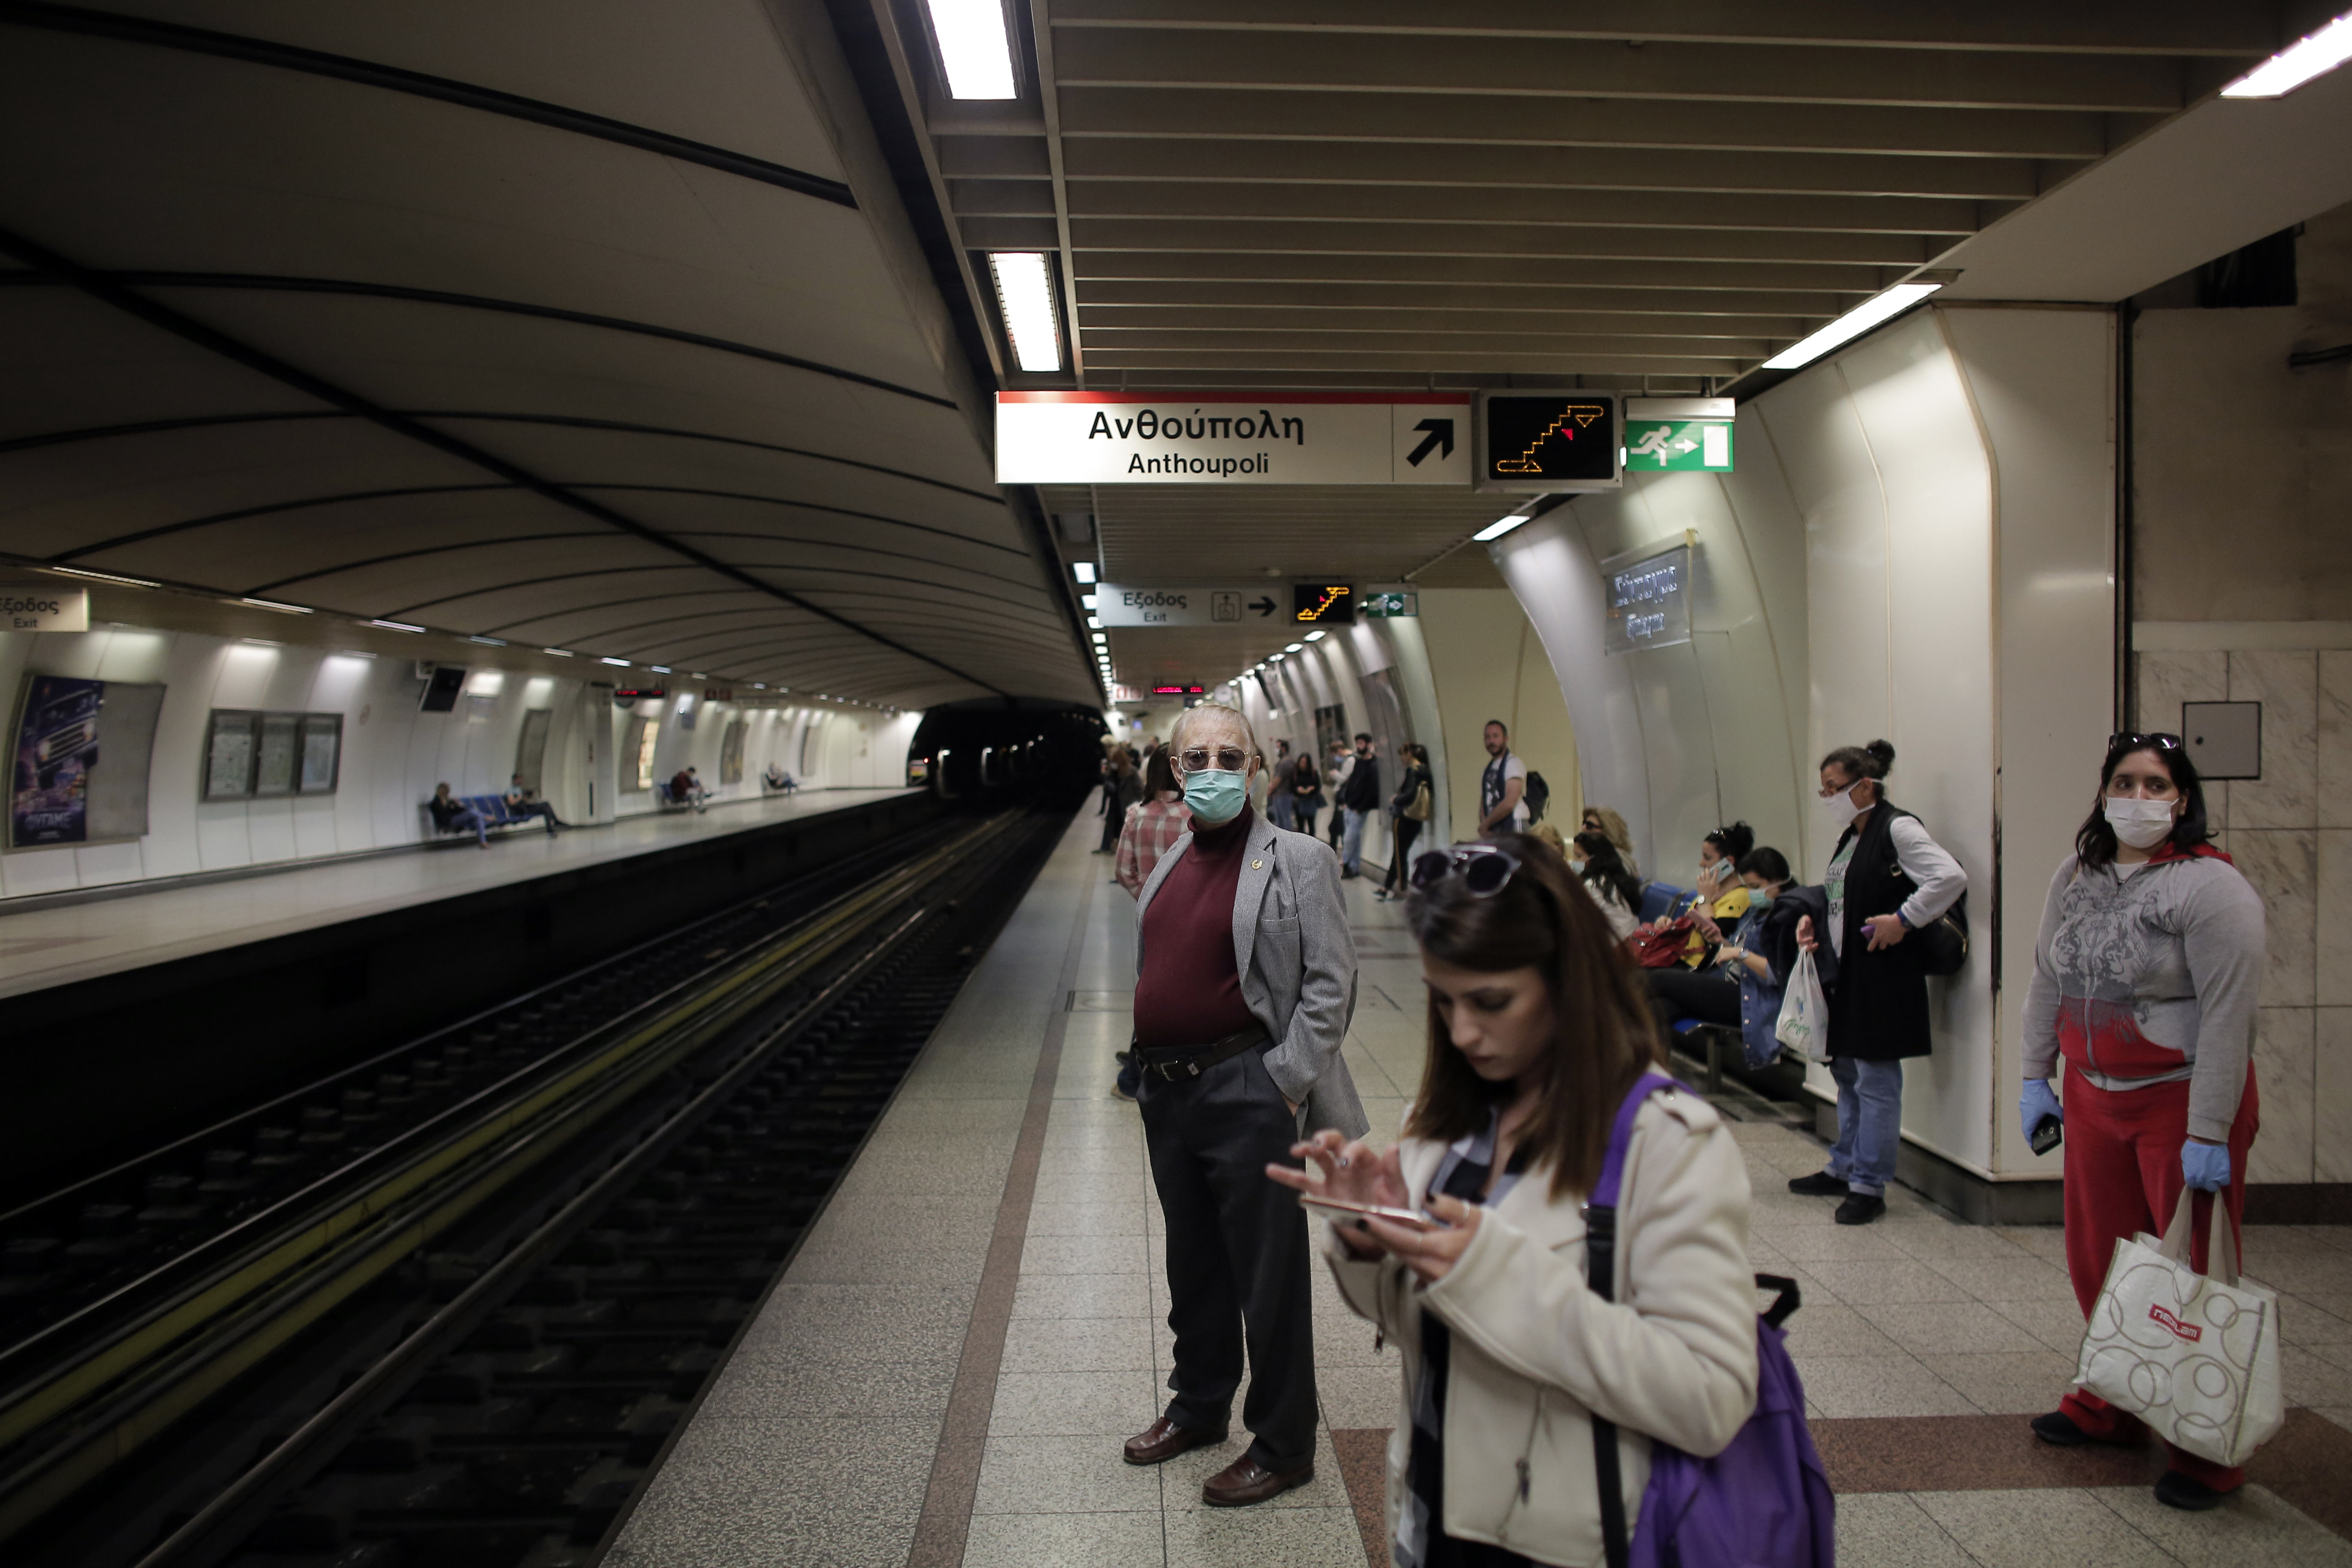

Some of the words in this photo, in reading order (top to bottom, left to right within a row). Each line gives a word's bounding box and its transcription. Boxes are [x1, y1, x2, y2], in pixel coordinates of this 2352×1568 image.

[1089, 408, 1303, 445] Ανθούπολη
[1128, 452, 1269, 477] Anthoupoli
[14, 618, 37, 628] Exit
[1144, 612, 1167, 622] Exit
